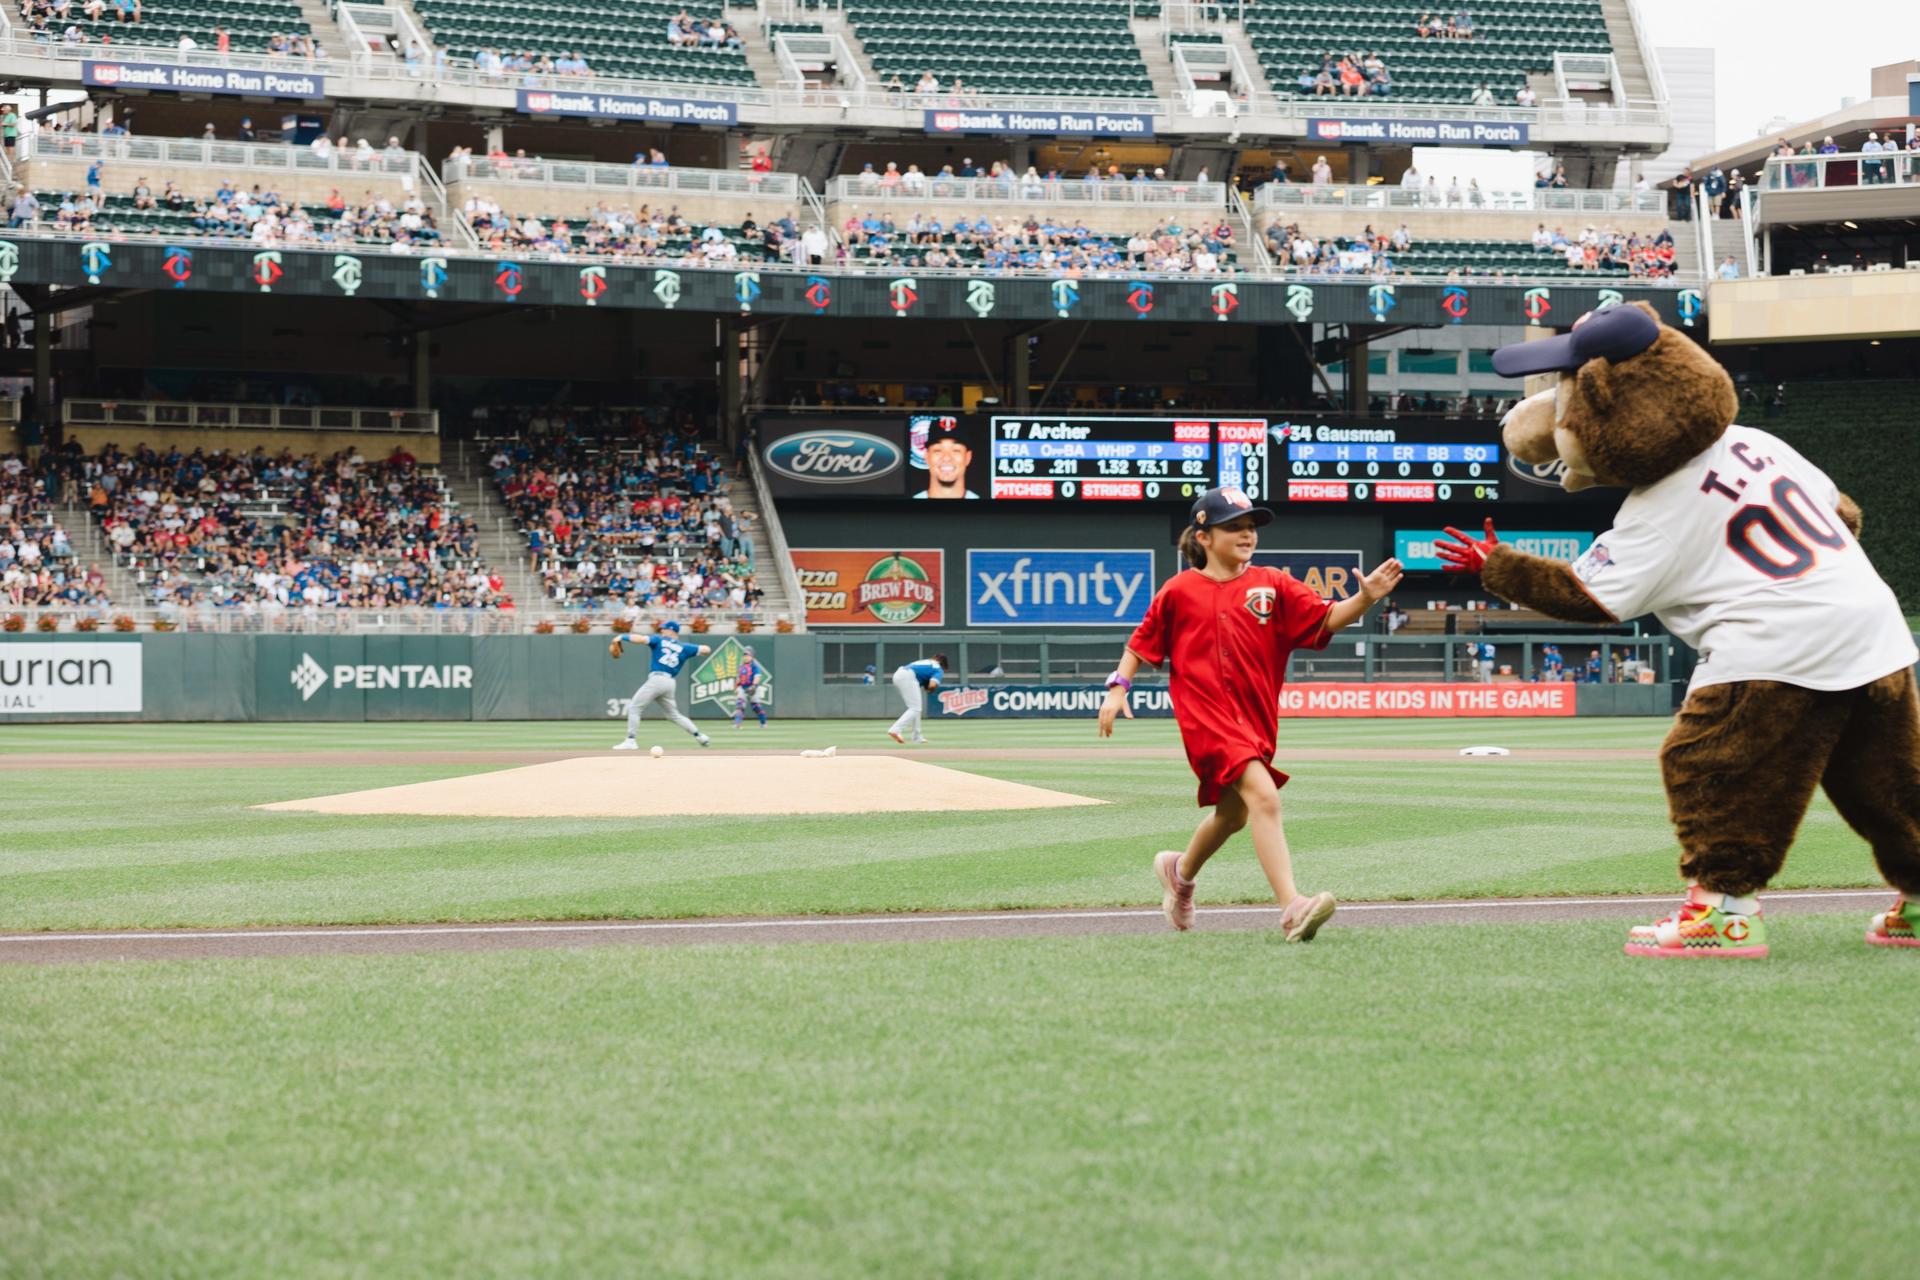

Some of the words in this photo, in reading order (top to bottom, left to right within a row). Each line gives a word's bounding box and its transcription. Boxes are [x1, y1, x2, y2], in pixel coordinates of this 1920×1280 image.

[173, 67, 224, 88] Home
[227, 73, 262, 91] Run
[264, 75, 314, 95] Porch
[599, 97, 646, 116] Home
[648, 101, 681, 118] Run
[683, 103, 729, 121] Porch
[1009, 114, 1058, 131] Home
[1060, 115, 1093, 132] Run
[1096, 116, 1144, 132] Porch
[1389, 122, 1437, 140] Home
[1439, 123, 1471, 140] Run
[1473, 124, 1520, 141] Porch
[1002, 423, 1021, 439] 17
[1029, 423, 1091, 440] Archer
[1174, 426, 1210, 440] 2022
[1218, 426, 1264, 441] TODAY
[1289, 426, 1312, 442] 34
[1316, 426, 1396, 443] Gausman
[791, 438, 876, 473] Ford
[999, 443, 1030, 457] ERA
[1096, 444, 1136, 458] WHIP
[1148, 445, 1162, 458] IP
[1182, 445, 1203, 458] SO
[1223, 444, 1238, 457] IP
[1241, 443, 1266, 457] 0.0
[1298, 447, 1314, 459] IP
[1337, 447, 1349, 460] H
[1366, 448, 1378, 460] R
[1393, 448, 1414, 460] ER
[1427, 448, 1449, 460] BB
[1463, 447, 1486, 460] SO
[998, 459, 1035, 474] 4.05
[1049, 459, 1077, 474] .211
[1097, 460, 1129, 475] 1.32
[1137, 460, 1168, 475] 73.1
[1182, 460, 1203, 475] 62
[1224, 458, 1237, 470] H
[1246, 457, 1259, 471] 0
[1291, 461, 1320, 476] 0.0
[1336, 461, 1349, 476] 0
[1366, 461, 1379, 476] 0
[1398, 461, 1411, 476] 0
[1432, 461, 1445, 476] 0
[1468, 461, 1482, 477] 0
[1219, 471, 1242, 485] BB
[1246, 471, 1259, 486] 0
[995, 483, 1054, 497] PITCHES
[1061, 482, 1075, 498] 0
[1082, 484, 1141, 497] STRIKES
[1146, 482, 1160, 499] 0
[1246, 485, 1260, 500] 0
[1288, 485, 1349, 499] PITCHES
[1354, 484, 1368, 500] 0
[1375, 485, 1434, 499] STRIKES
[1437, 484, 1451, 501] 0
[1726, 474, 1847, 580] 00
[1516, 538, 1580, 563] SELTZER
[860, 581, 902, 602] BREW
[903, 579, 934, 602] PUB
[977, 557, 1145, 618] xfinity
[880, 607, 916, 621] PIZZA
[333, 665, 473, 689] PENTAIR
[0, 695, 36, 708] IAL
[607, 698, 632, 717] 37
[938, 688, 989, 715] Twins
[1133, 691, 1174, 710] FUN
[1309, 690, 1371, 709] MORE
[1375, 690, 1426, 709] KIDS
[1430, 690, 1452, 709] IN
[1456, 690, 1498, 709] THE
[1502, 690, 1563, 709] GAME
